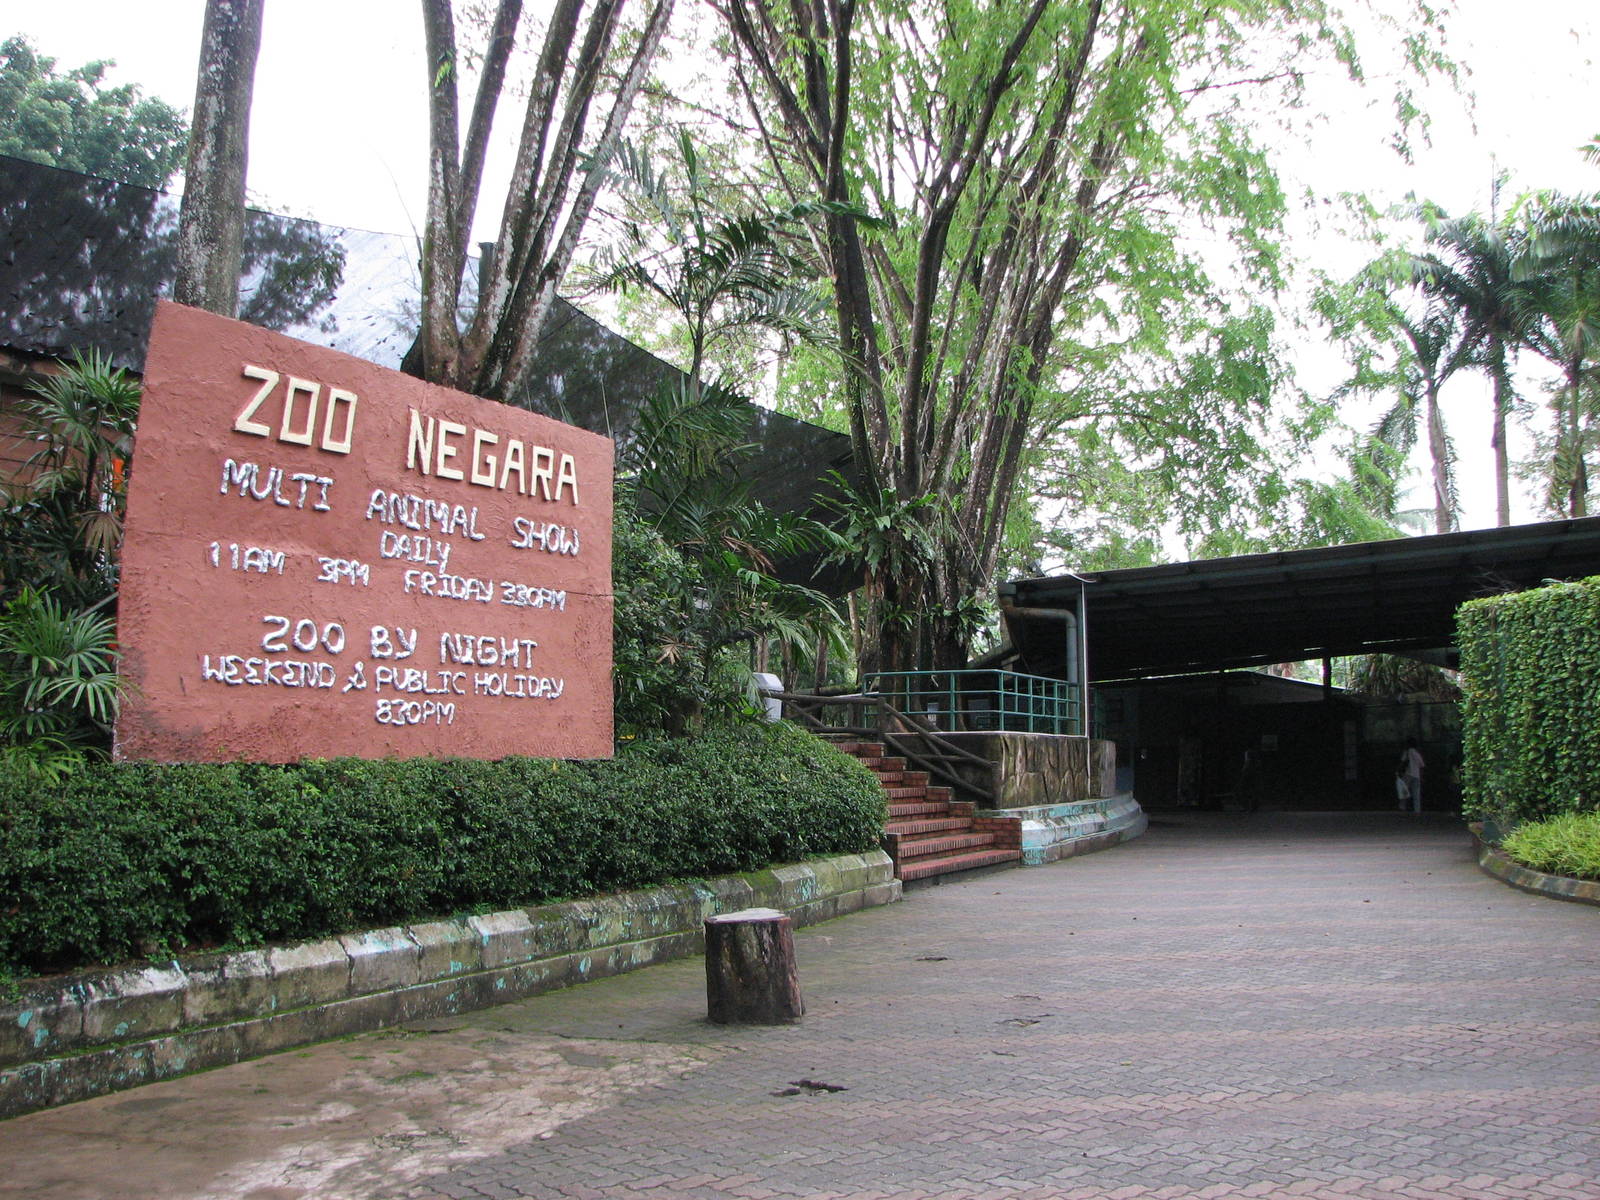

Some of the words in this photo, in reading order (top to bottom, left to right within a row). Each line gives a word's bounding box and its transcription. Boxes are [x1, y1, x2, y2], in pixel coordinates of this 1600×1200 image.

[233, 365, 359, 455] ZOO
[406, 406, 580, 504] NEGARA
[220, 458, 334, 511] MULTI
[366, 486, 486, 541] ANIMAL
[511, 516, 581, 557] SHOW
[379, 531, 452, 574] DAILY
[208, 541, 286, 575] 11AM
[317, 556, 370, 587] 3PM
[403, 570, 494, 603] FRIDAY
[500, 582, 567, 611] 330PM
[370, 625, 417, 660] BY
[439, 631, 539, 670] NIGHT
[202, 654, 336, 689] WEEKEND
[341, 661, 367, 694] &
[375, 666, 466, 697] PUBLIC
[474, 670, 565, 700] HOLIDAY
[375, 699, 455, 726] 830PM
